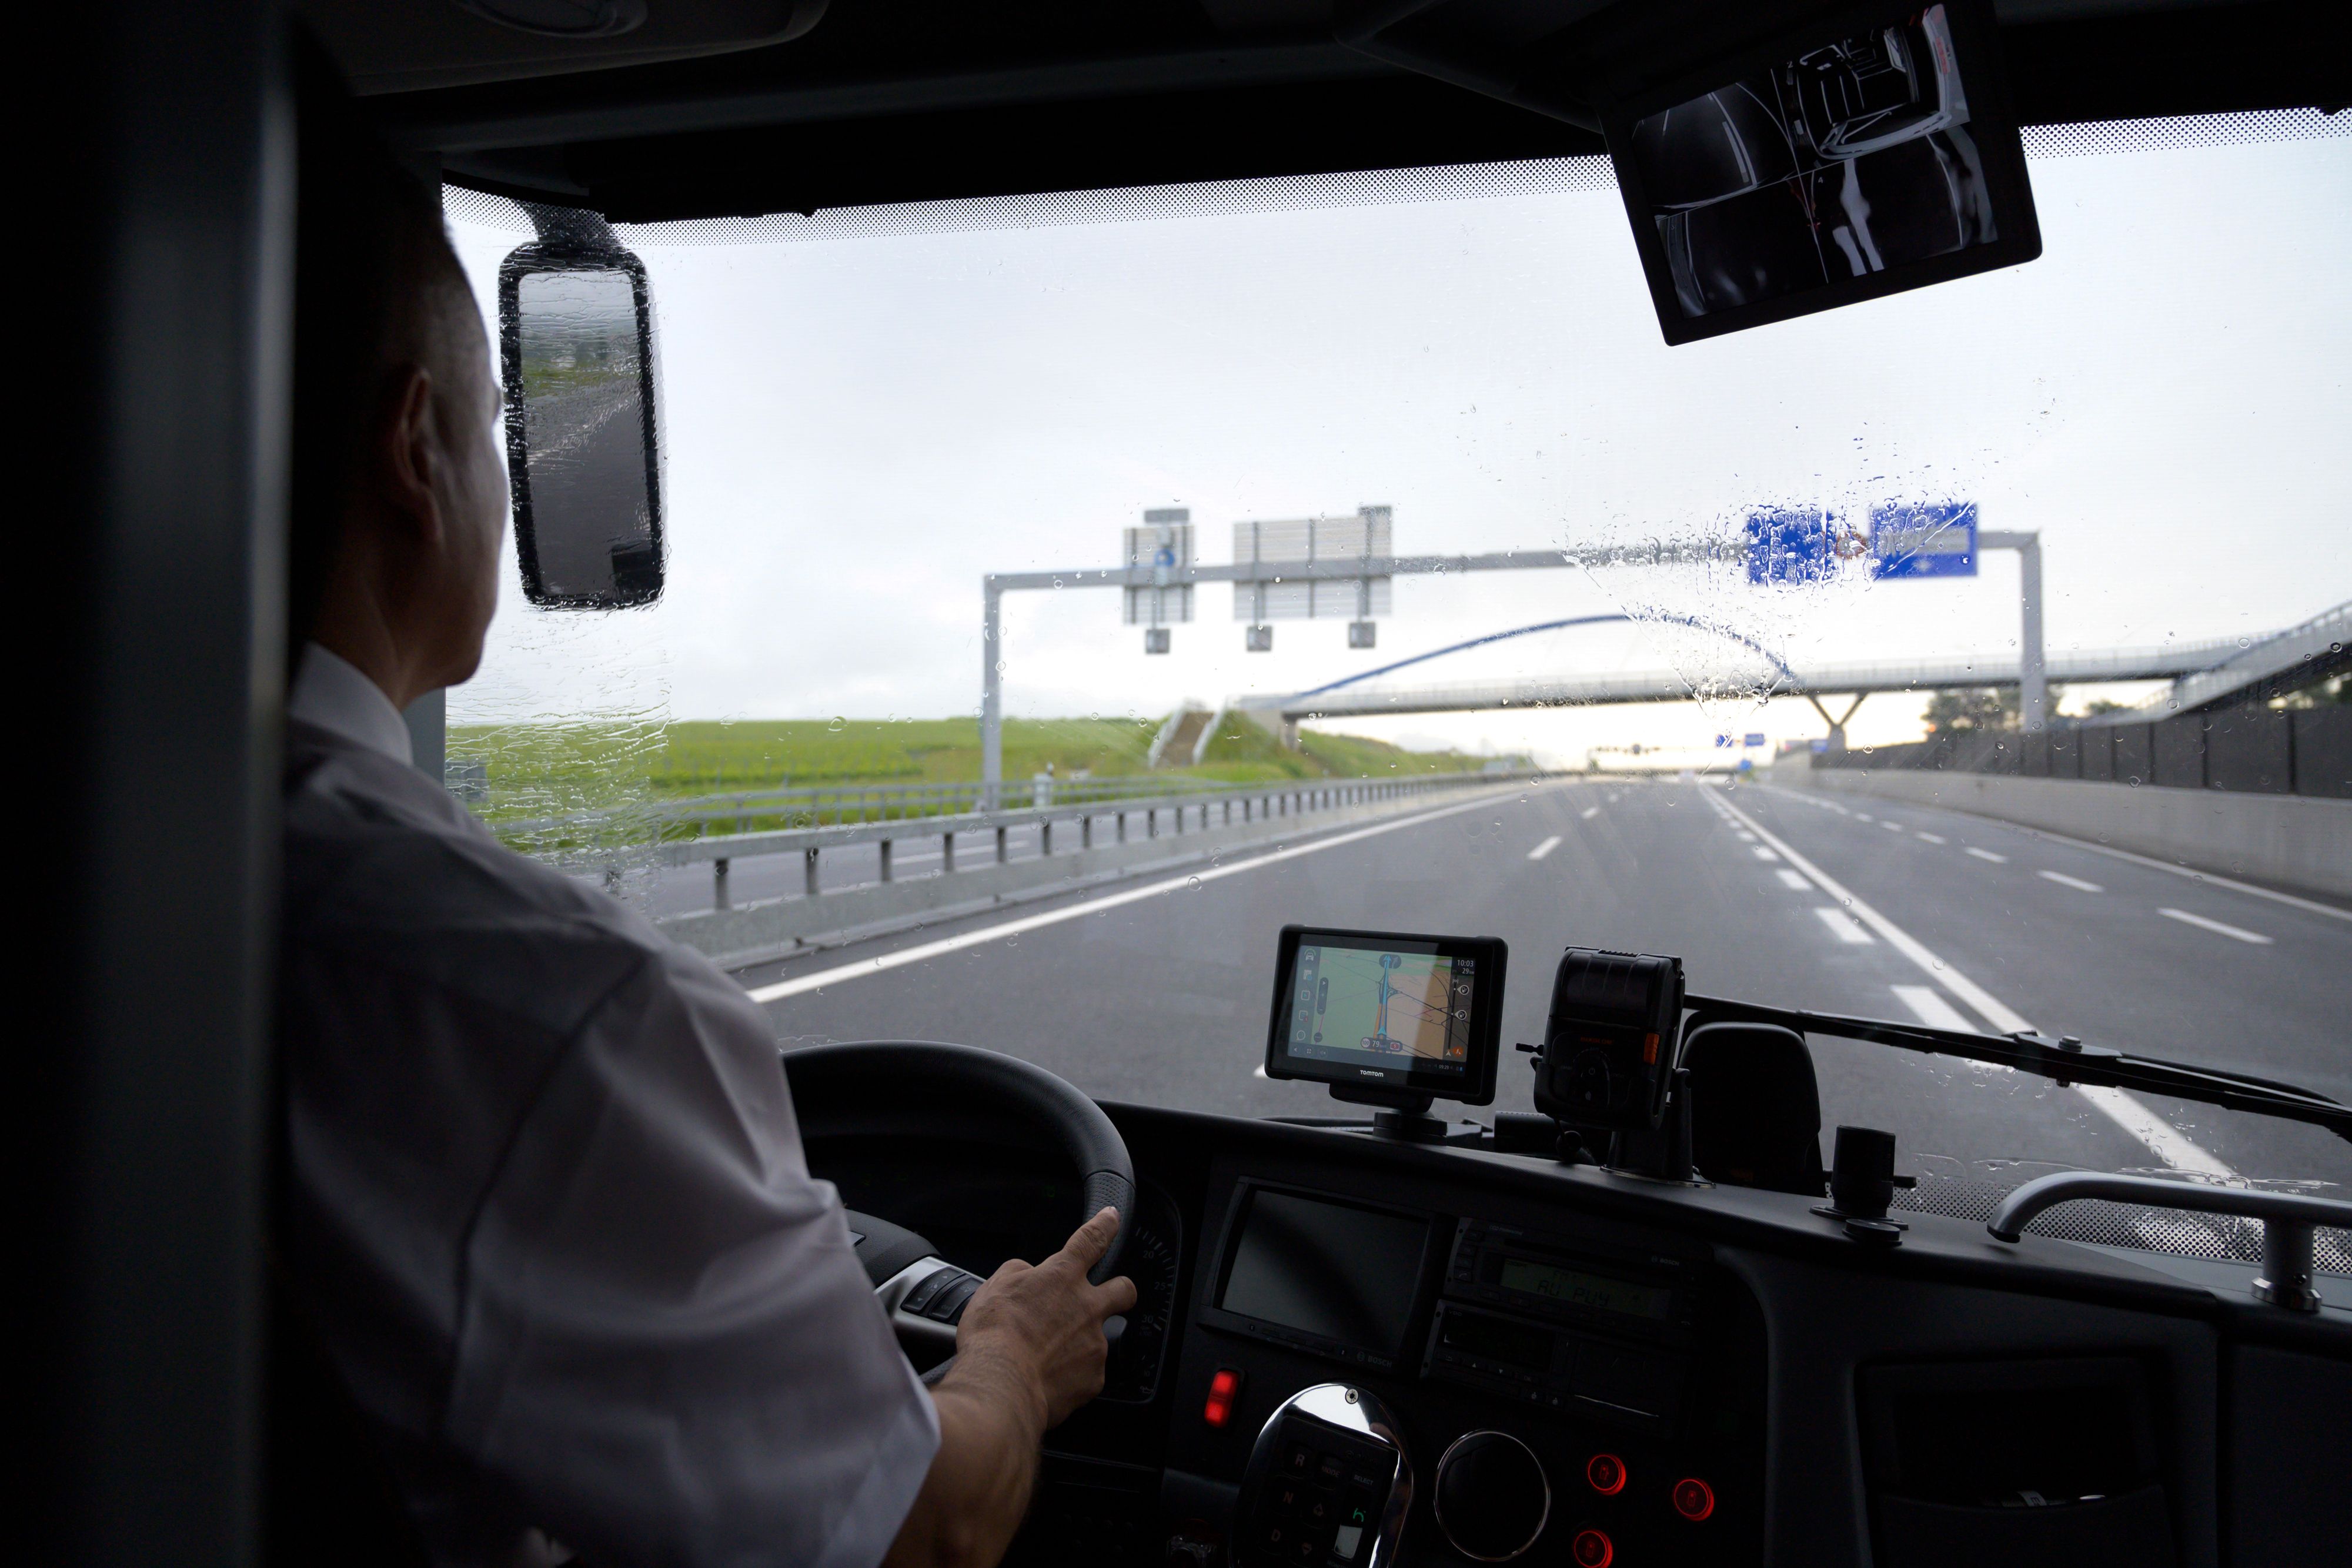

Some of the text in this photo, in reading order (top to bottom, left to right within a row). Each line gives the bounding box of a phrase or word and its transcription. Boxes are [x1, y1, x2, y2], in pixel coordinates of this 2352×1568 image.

[1457, 959, 1474, 967] 10:03
[1372, 1039, 1379, 1048] 79
[1142, 1250, 1154, 1259] 20
[1154, 1281, 1166, 1290] 25
[1141, 1315, 1154, 1323] 30
[1368, 1355, 1392, 1368] BOSCH
[1295, 1453, 1305, 1467] R
[1321, 1465, 1341, 1477] MODE
[1354, 1474, 1374, 1486] SELECT
[1282, 1490, 1294, 1505] N
[1271, 1528, 1281, 1542] D
